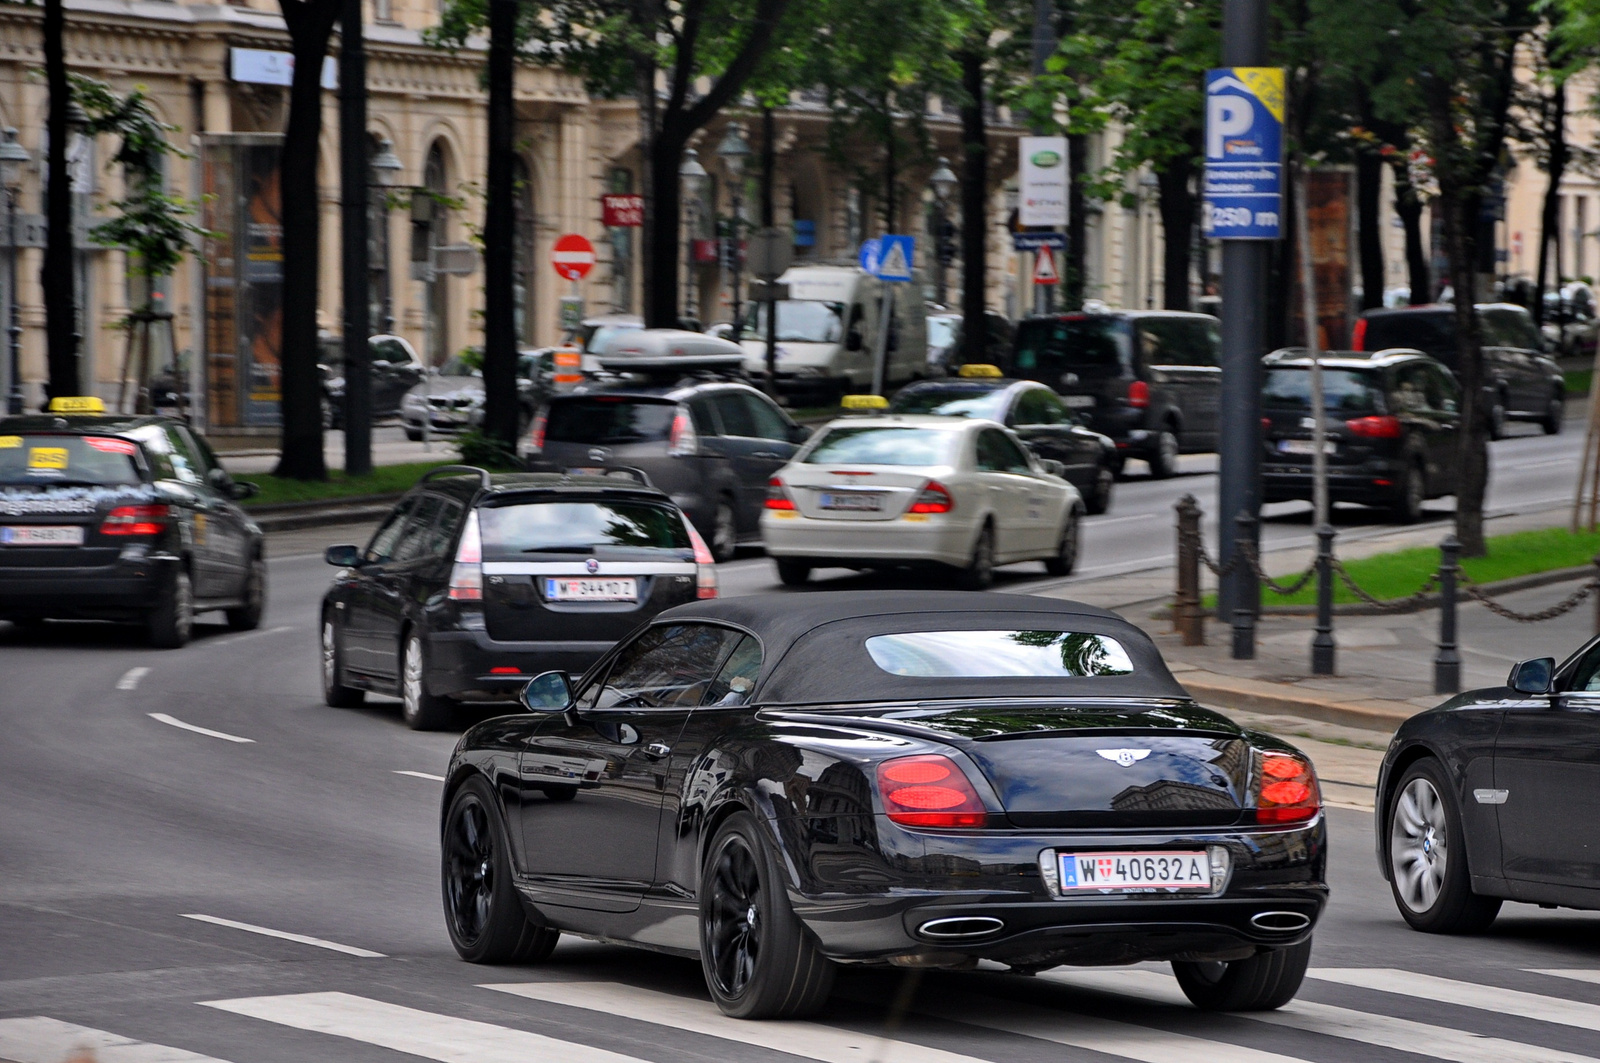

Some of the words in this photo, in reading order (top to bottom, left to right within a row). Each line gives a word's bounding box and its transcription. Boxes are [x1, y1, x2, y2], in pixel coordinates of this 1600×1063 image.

[1207, 95, 1254, 158] P
[1255, 211, 1278, 226] m
[1080, 859, 1096, 882] W
[1116, 857, 1202, 882] 40632A
